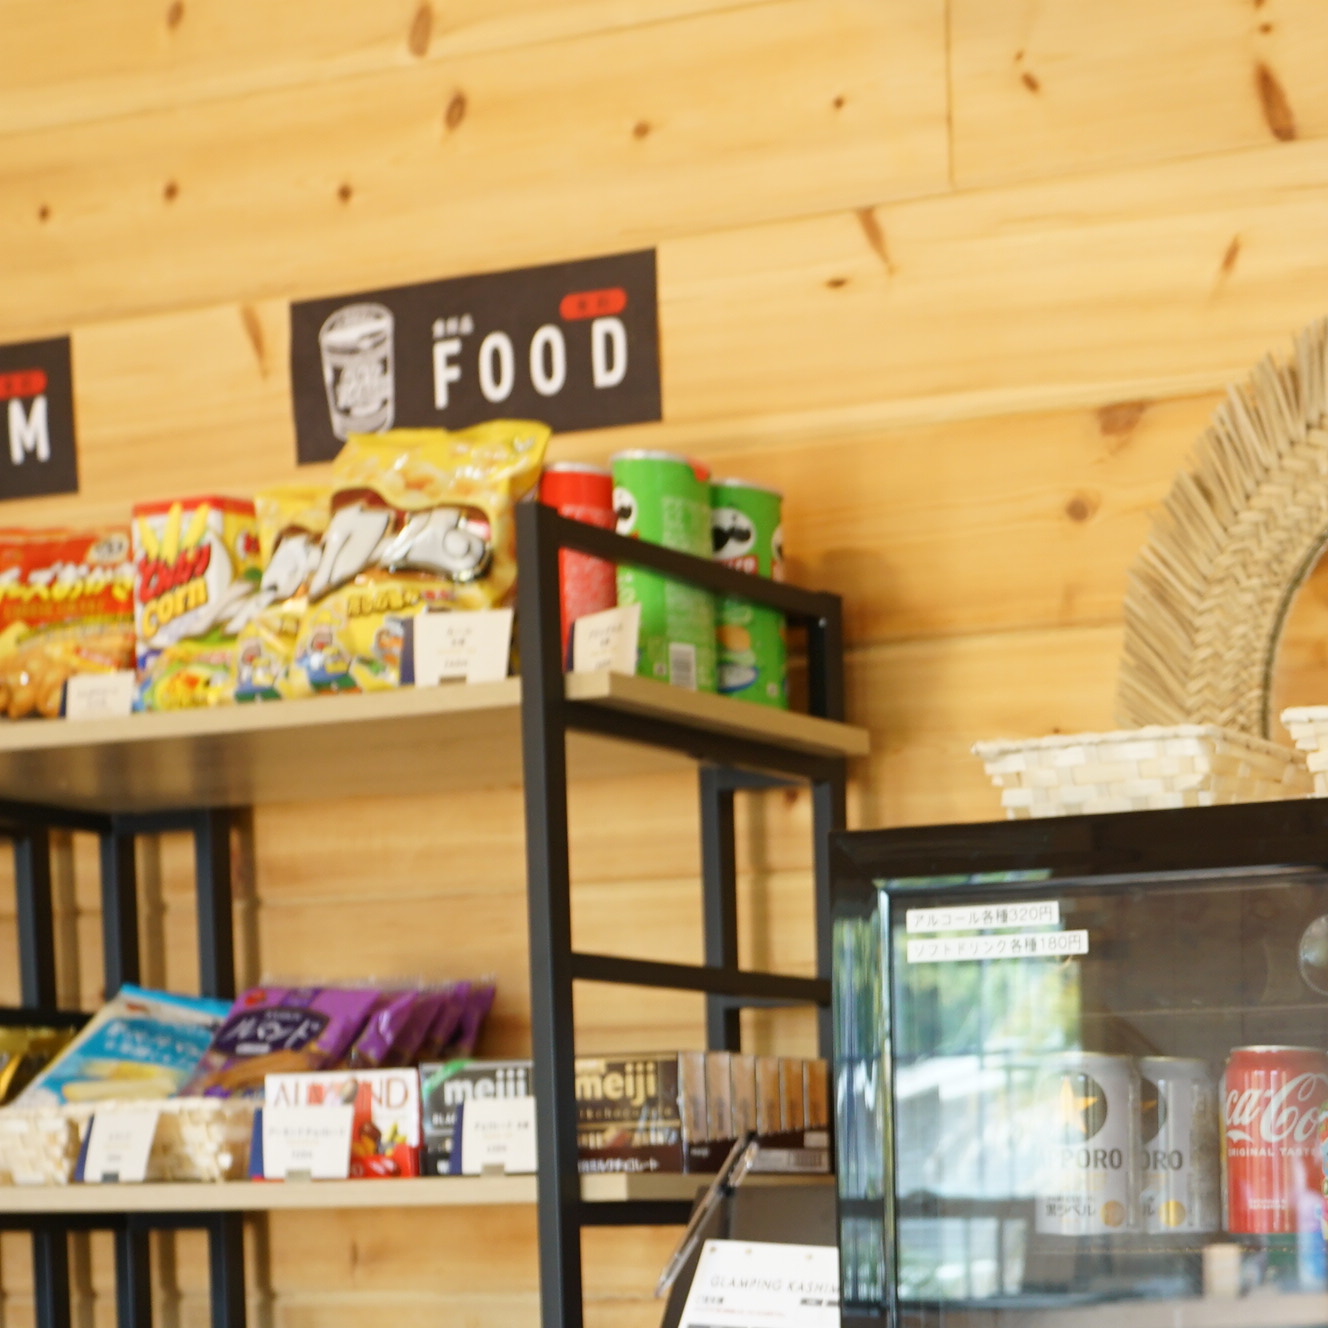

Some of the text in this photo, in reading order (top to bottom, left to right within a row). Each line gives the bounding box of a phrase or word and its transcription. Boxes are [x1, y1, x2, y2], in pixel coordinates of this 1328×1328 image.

[433, 316, 628, 410] FOOD
[914, 905, 1052, 926] アルコール各種320円
[915, 934, 1081, 959] ソフトドリンク各種180円
